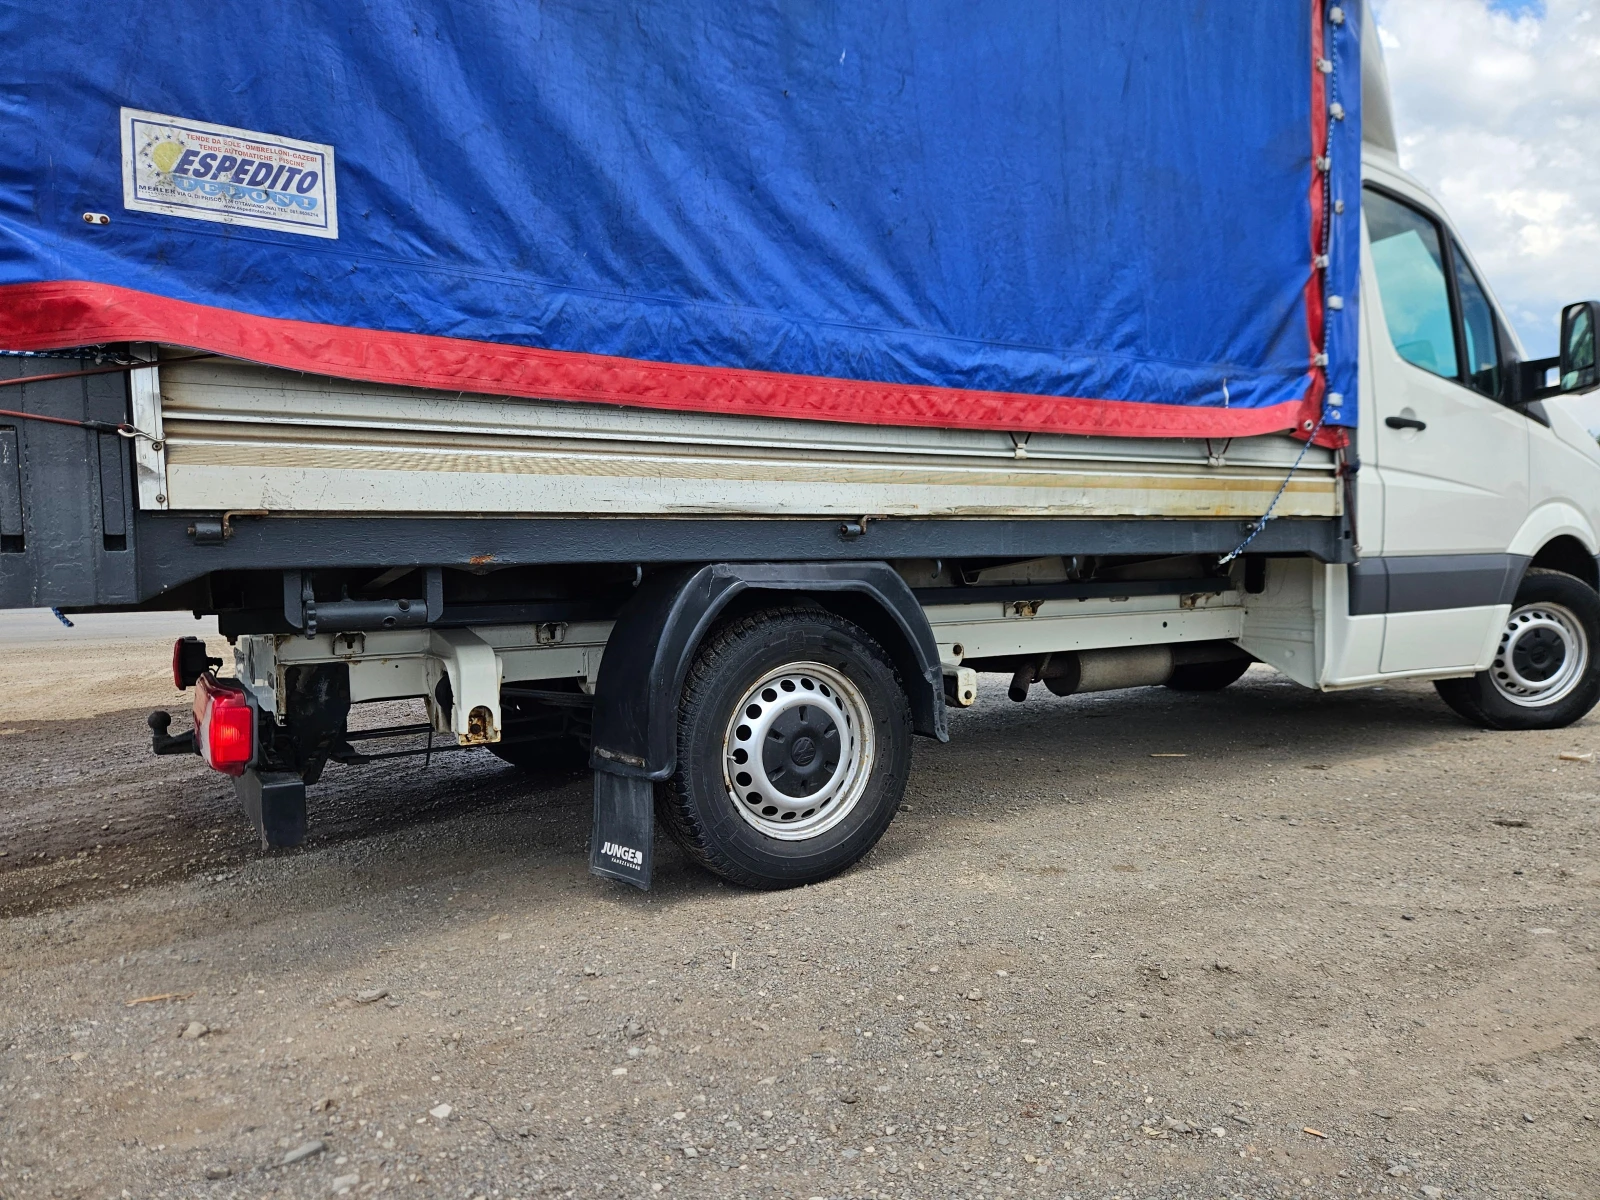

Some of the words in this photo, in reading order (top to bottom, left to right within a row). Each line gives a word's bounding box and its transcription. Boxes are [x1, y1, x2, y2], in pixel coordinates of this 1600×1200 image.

[186, 133, 210, 143] TENDE
[223, 140, 241, 148] SOLE
[198, 143, 222, 153] TENDE
[224, 147, 273, 161] AUTOMATICHE
[278, 157, 305, 168] PISCINE
[173, 148, 319, 195] ESPEDITO
[179, 177, 311, 207] TELONI
[601, 842, 635, 861] JUNGE
